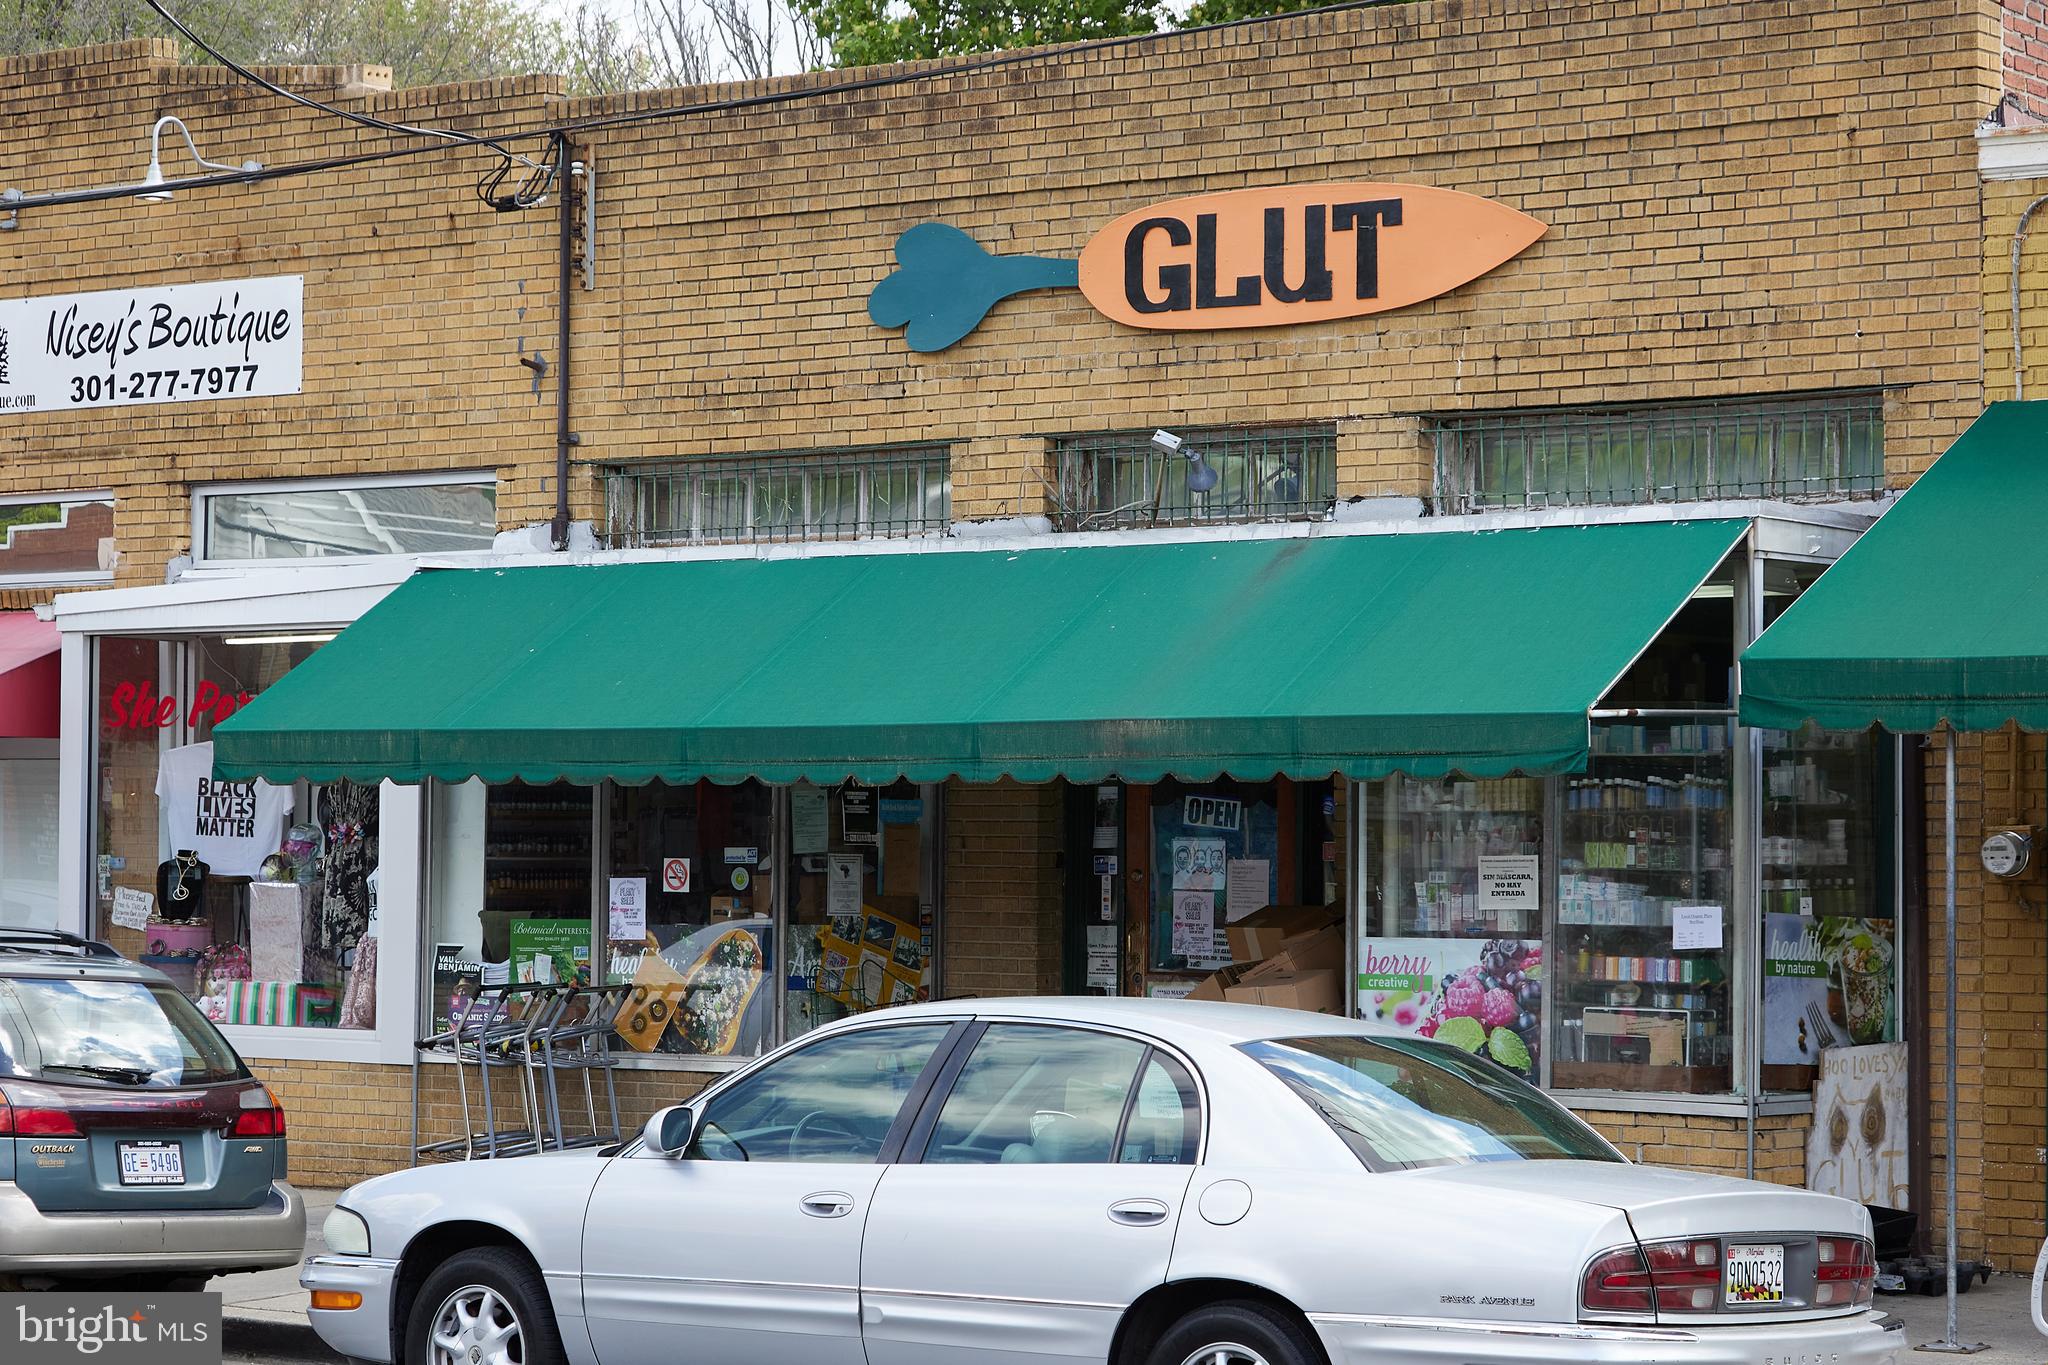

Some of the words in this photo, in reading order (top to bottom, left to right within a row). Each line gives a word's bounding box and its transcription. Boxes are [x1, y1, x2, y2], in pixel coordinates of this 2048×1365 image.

[1124, 197, 1403, 314] GLUT
[46, 298, 142, 369] Nisey's
[147, 291, 291, 362] Boutique
[70, 364, 259, 403] 301-277-7977
[106, 680, 180, 729] She
[198, 777, 257, 798] BLACK
[196, 797, 255, 819] LIVES
[1187, 797, 1238, 828] OPEN
[195, 817, 255, 838] MATTER
[513, 922, 557, 934] Botanical
[556, 927, 589, 935] INTERESTS
[438, 962, 481, 973] BENJAMIN
[1365, 944, 1432, 993] berry
[1775, 961, 1786, 976] by
[1787, 963, 1816, 975] nature
[1368, 976, 1409, 988] creative
[452, 1011, 483, 1022] ORANIC
[1852, 1053, 1889, 1080] LOVES
[31, 1144, 76, 1154] OUTBACK
[243, 1145, 263, 1153] AWD
[123, 1152, 140, 1172] GE
[150, 1152, 179, 1172] 5496
[1729, 1260, 1782, 1289] 9DN0532
[1440, 1295, 1476, 1305] PARK
[1478, 1295, 1535, 1307] AVENUE
